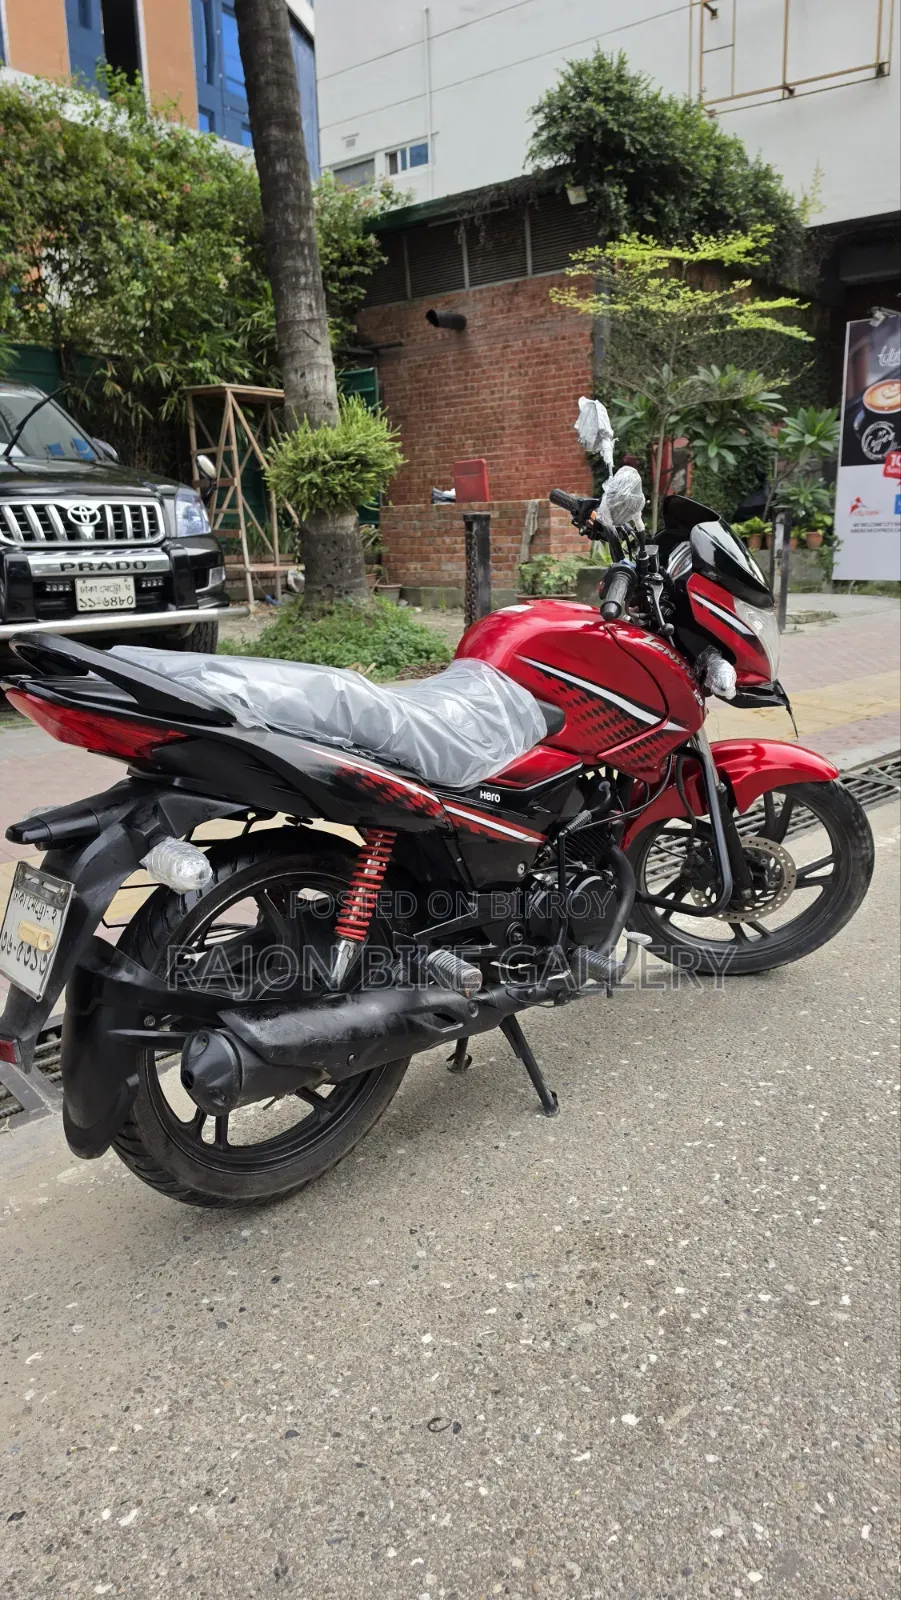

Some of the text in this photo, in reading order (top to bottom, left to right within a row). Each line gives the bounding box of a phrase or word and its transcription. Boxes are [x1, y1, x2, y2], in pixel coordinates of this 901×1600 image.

[60, 560, 148, 572] PRADO
[79, 595, 134, 608] ১১-৬৪৮০
[479, 790, 501, 803] Hero
